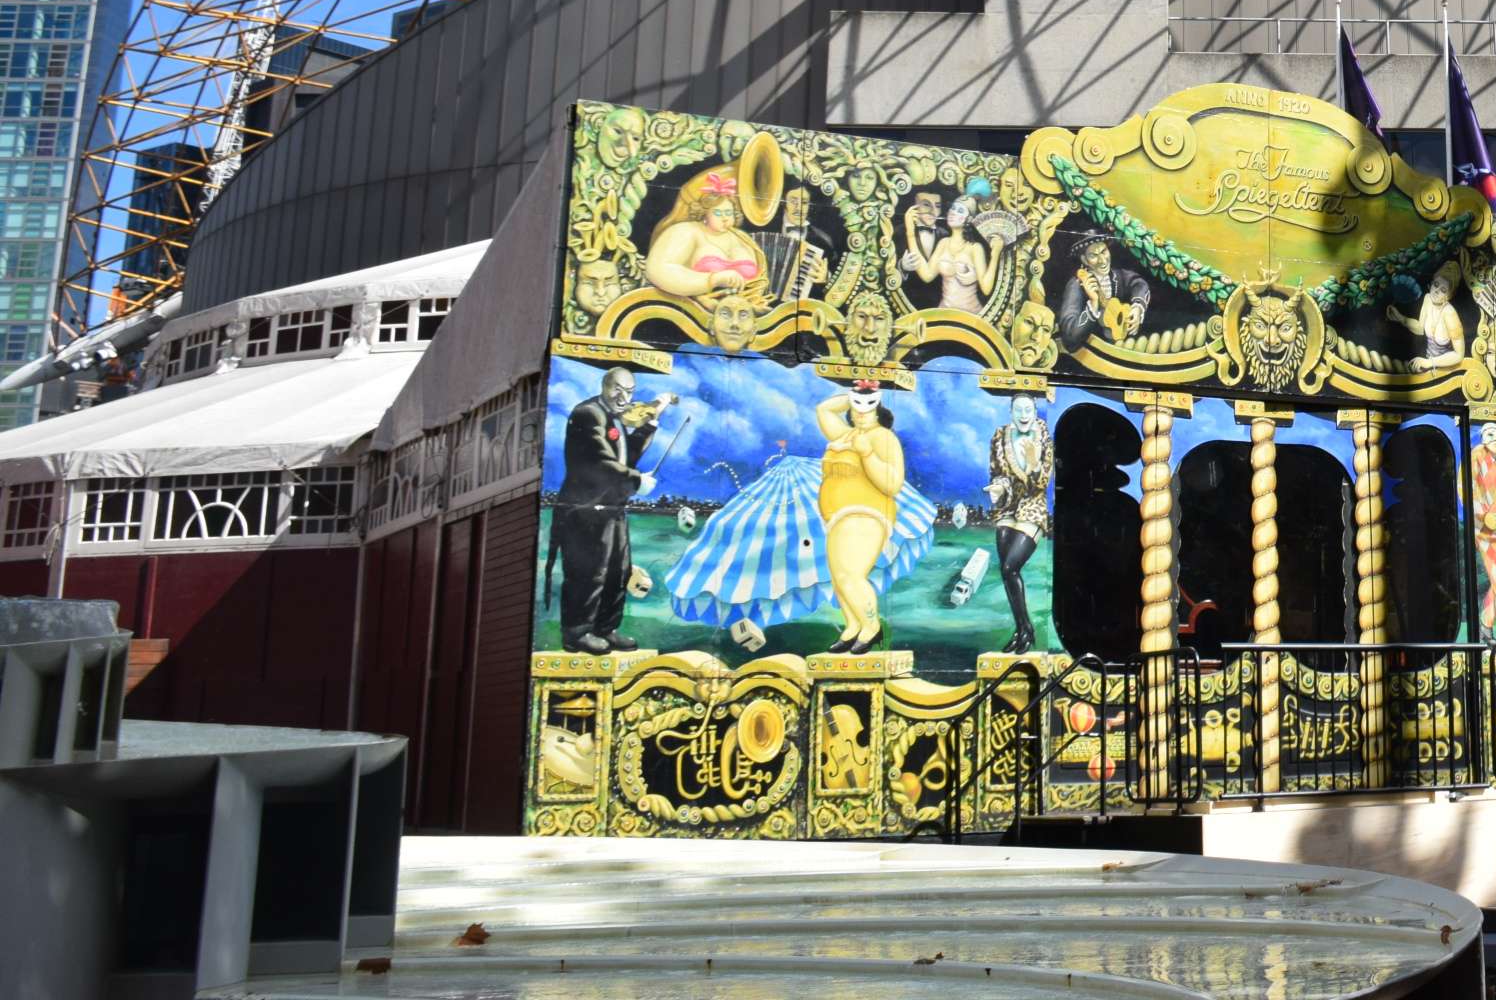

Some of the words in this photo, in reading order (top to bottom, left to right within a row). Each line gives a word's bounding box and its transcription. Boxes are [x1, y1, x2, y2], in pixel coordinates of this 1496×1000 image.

[1224, 88, 1265, 107] ANNO
[1279, 97, 1312, 113] 1920
[1236, 150, 1268, 172] The
[1259, 146, 1329, 180] Famous
[1174, 169, 1360, 232] Spiegeltent
